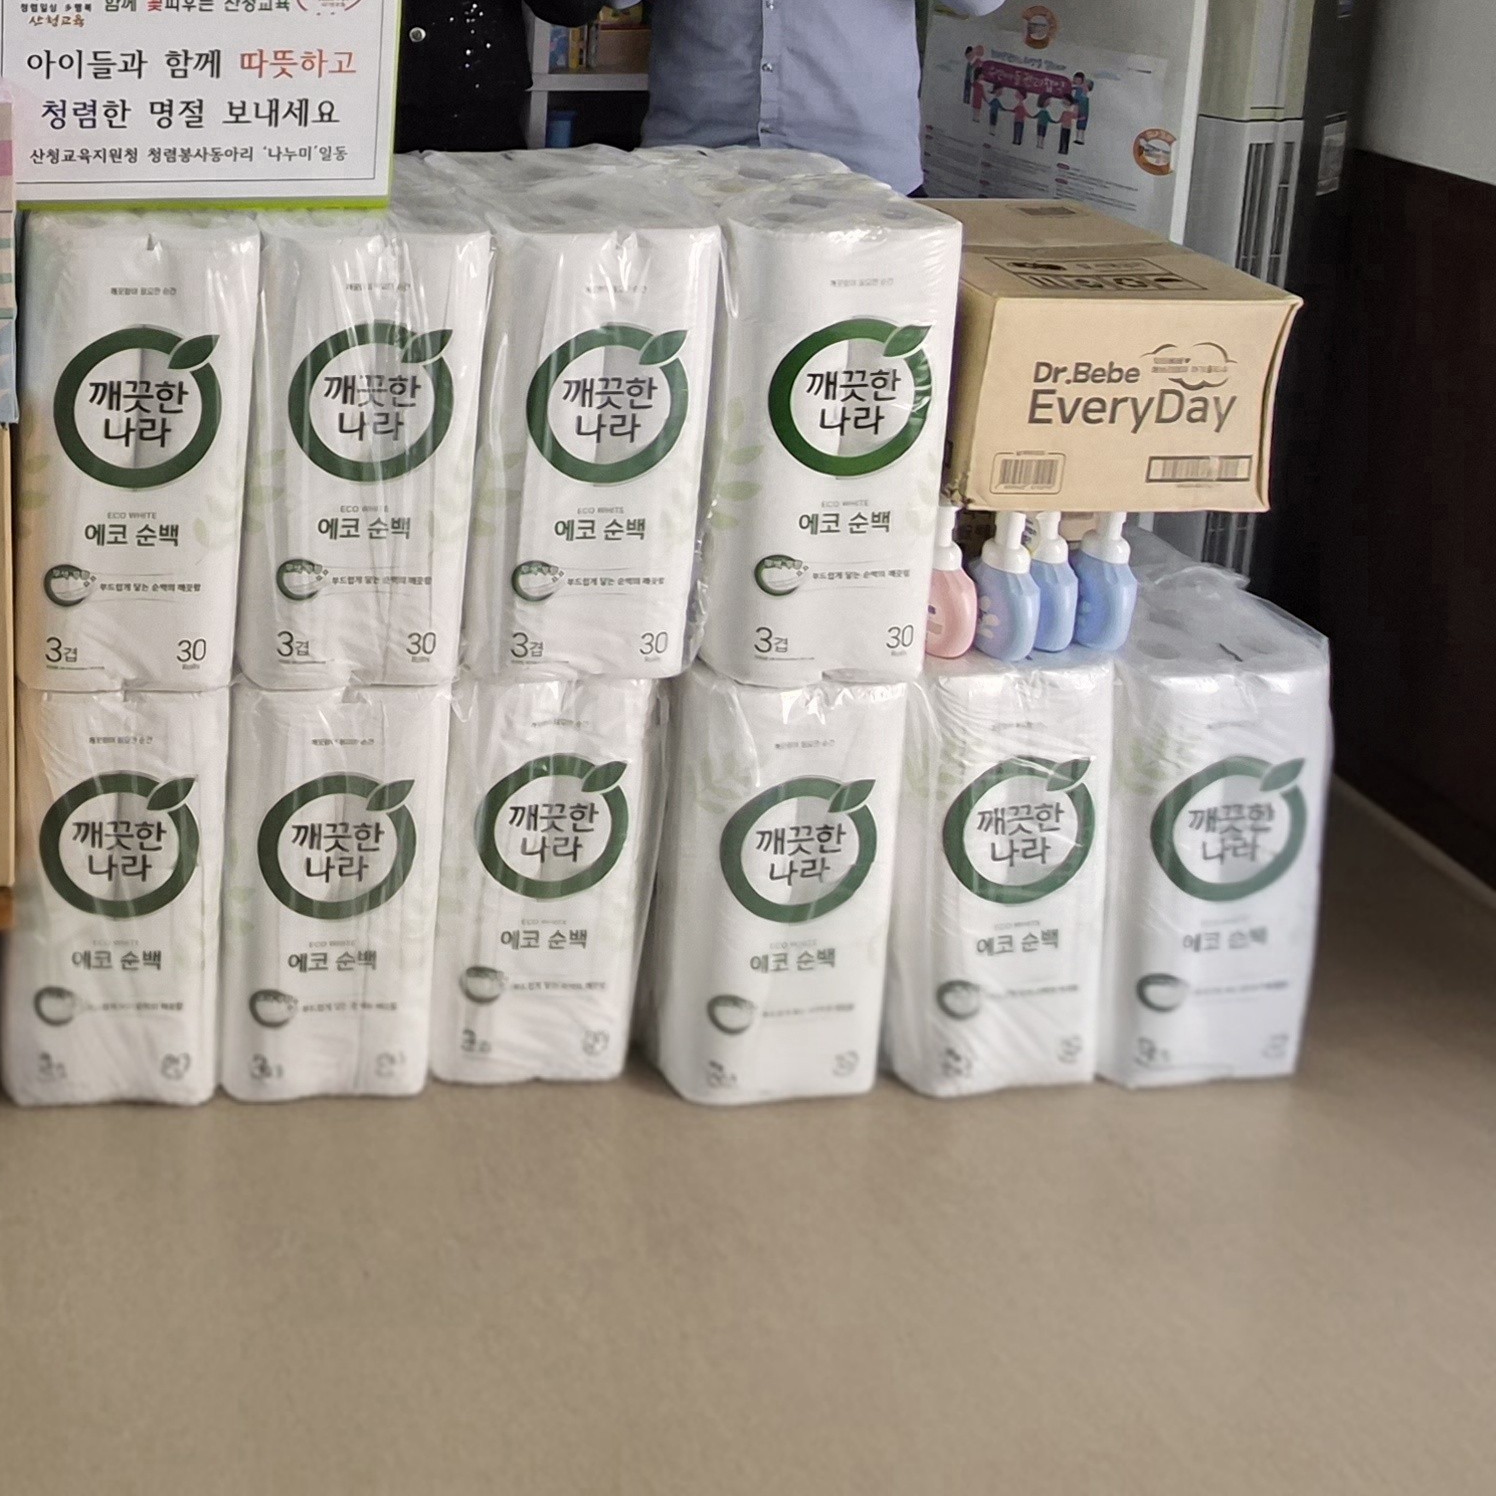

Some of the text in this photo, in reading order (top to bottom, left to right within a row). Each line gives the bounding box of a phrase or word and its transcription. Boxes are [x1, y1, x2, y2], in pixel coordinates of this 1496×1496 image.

[28, 14, 85, 28] 산청교육
[26, 49, 357, 80] 아이들과 함께 따뜻하고
[40, 98, 341, 130] 청렴한 명절 보내세요
[29, 146, 139, 165] 산청교육지원청
[147, 146, 254, 164] 청렴봉사동아리
[806, 368, 902, 403] 깨끗한
[1033, 361, 1141, 385] Dr.Bebe
[88, 380, 189, 414] 깨끗한
[323, 375, 423, 409] 깨끗한
[562, 376, 659, 410] 깨끗한
[819, 406, 885, 436] 나라
[1027, 388, 1238, 434] EveryDay
[104, 418, 172, 448] 나라
[339, 412, 404, 441] 나라
[576, 413, 642, 444] 나라
[84, 524, 179, 547] 에코 순백
[318, 517, 411, 540] 에코 순백
[554, 518, 646, 541] 에코 순백
[798, 511, 891, 535] 에코 순백
[45, 636, 78, 663] 3겹
[176, 638, 207, 663] 30
[276, 630, 310, 658] 3겹
[406, 631, 437, 656] 30
[510, 632, 544, 659] 3겹
[639, 630, 669, 656] 30
[754, 626, 789, 654] 3겹
[885, 624, 914, 650] 30
[509, 802, 599, 834] 깨끗한
[976, 802, 1065, 836] 깨끗한
[72, 820, 167, 854] 깨끗한
[291, 821, 385, 854] 깨끗한
[520, 836, 583, 864] 나라
[755, 823, 847, 857] 깨끗한
[1201, 832, 1262, 863] 나라
[990, 838, 1051, 867] 나라
[87, 856, 153, 883] 나라
[305, 856, 369, 883] 나라
[768, 859, 831, 886] 나라
[500, 928, 588, 950] 에코 순백
[976, 929, 1059, 957] 에코 순백
[71, 950, 163, 971] 에코 순백
[288, 950, 378, 973] 에코 순백
[750, 947, 837, 974] 에코 순백
